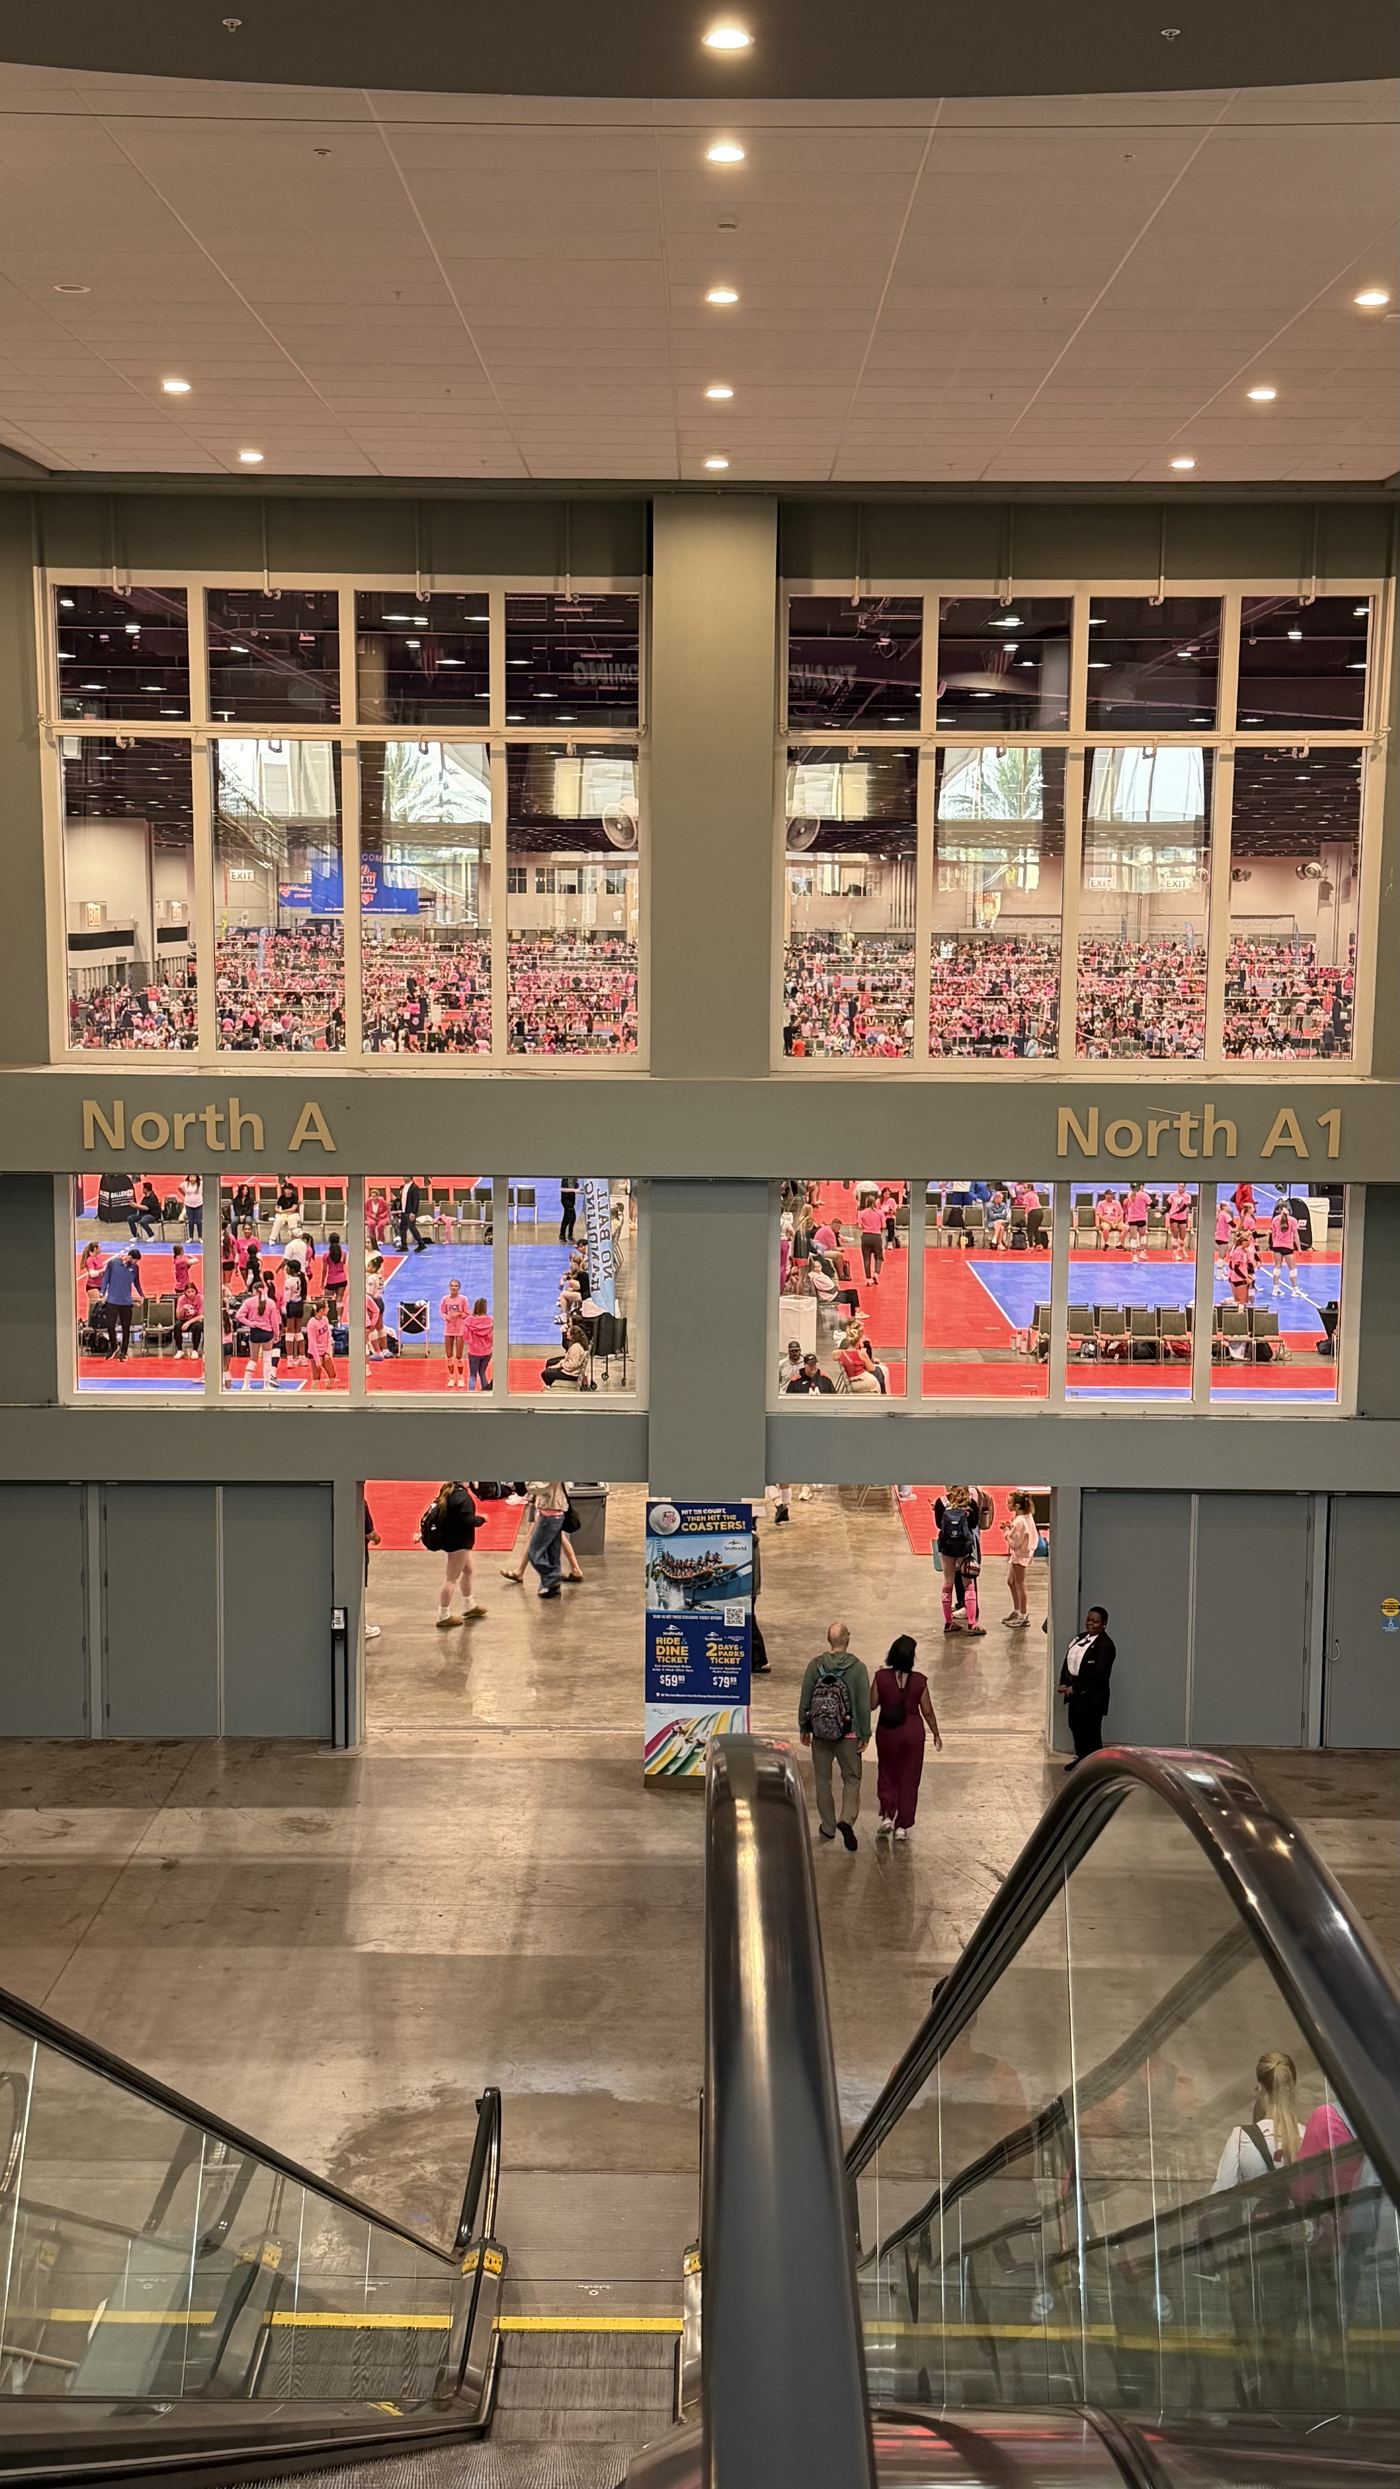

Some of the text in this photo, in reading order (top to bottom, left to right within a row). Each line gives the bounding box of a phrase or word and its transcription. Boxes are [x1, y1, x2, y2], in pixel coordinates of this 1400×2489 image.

[231, 872, 252, 880] EXIT
[1091, 879, 1111, 887] EXIT
[1166, 880, 1187, 888] EXIT
[82, 1098, 336, 1152] North A
[1057, 1104, 1341, 1158] North A1
[681, 1521, 746, 1531] COASTERS!
[656, 1637, 680, 1645] RIDE
[656, 1646, 689, 1656] DINE
[706, 1642, 718, 1657] 2
